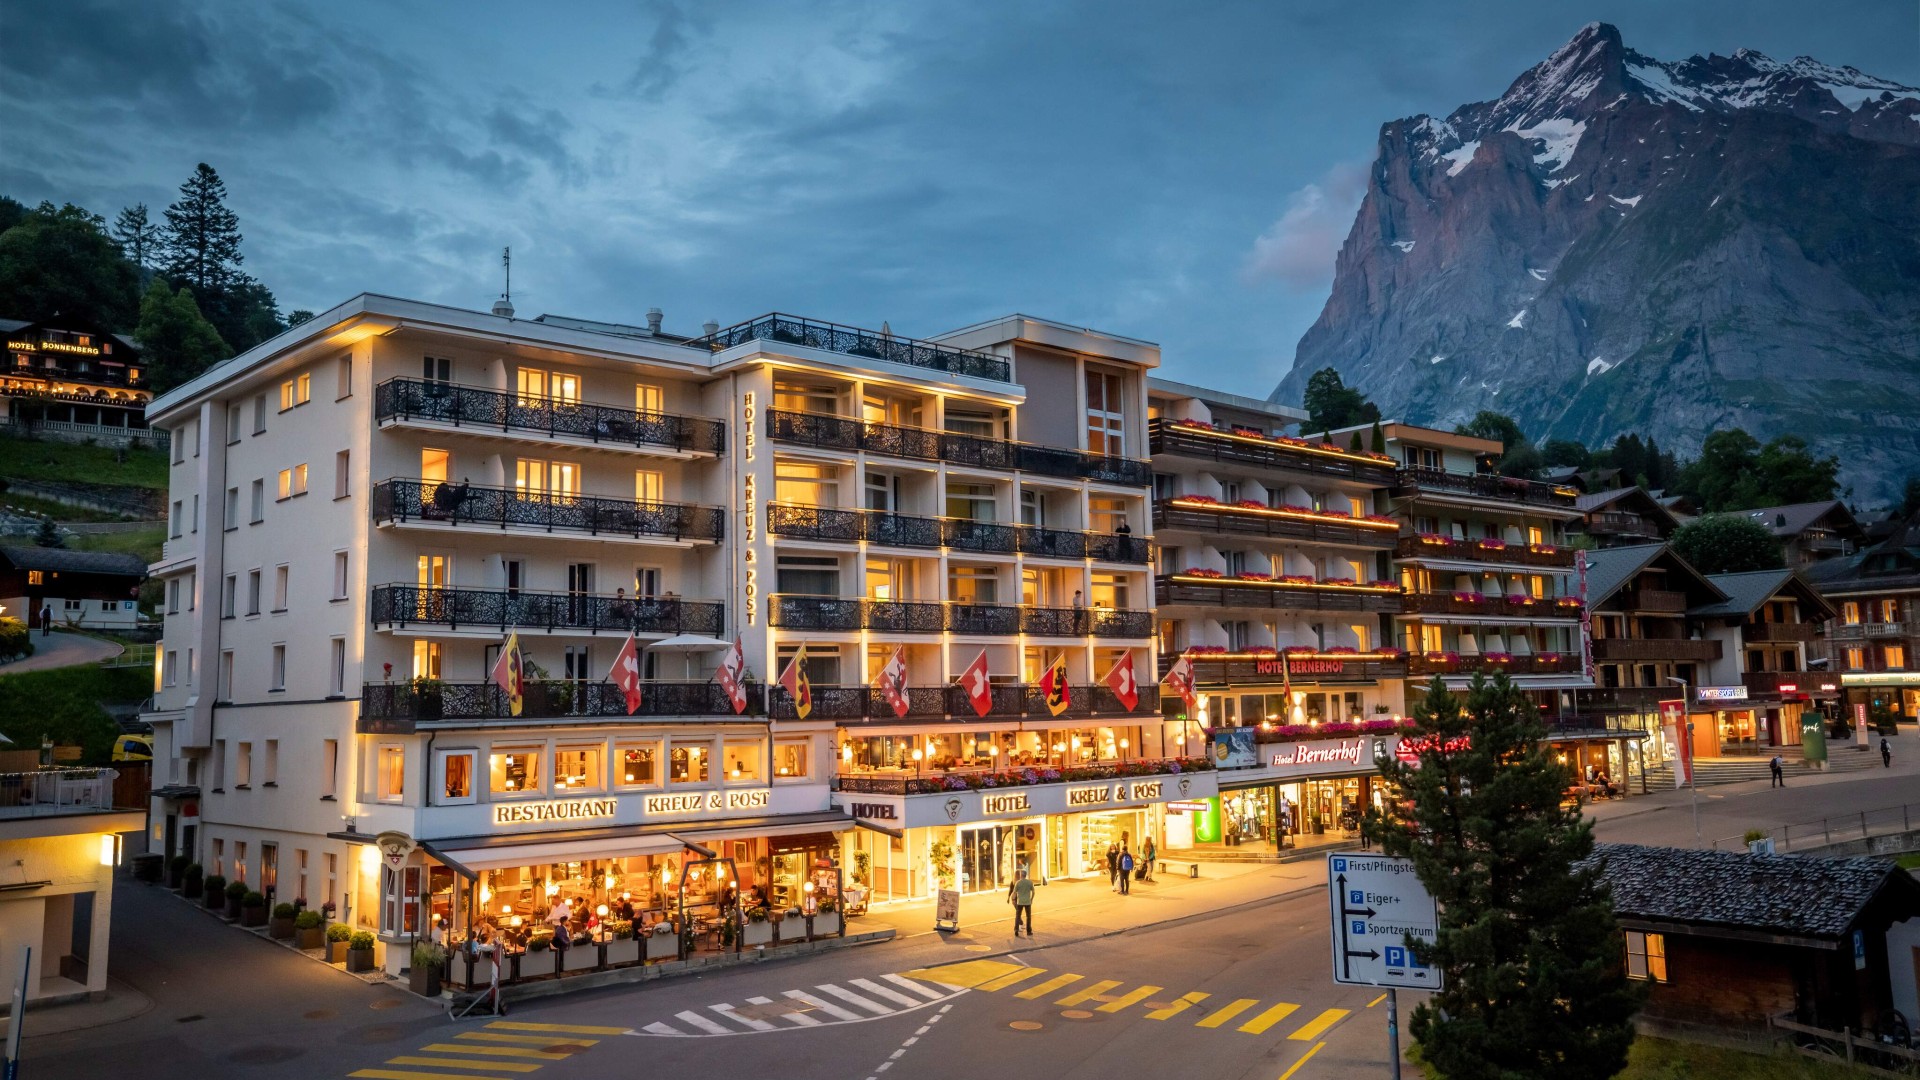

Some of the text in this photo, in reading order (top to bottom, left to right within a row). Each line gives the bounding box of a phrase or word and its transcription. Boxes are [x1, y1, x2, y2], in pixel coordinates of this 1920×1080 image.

[8, 341, 99, 355] HOTEL SONNENBERG
[744, 393, 755, 624] HOTEL KREUZ & POST
[1257, 660, 1344, 674] HOTE BERNERHOF
[1274, 740, 1365, 766] Hotel Bernerhof
[985, 783, 1163, 813] HOTEL KREUZ & POST
[496, 791, 770, 822] RESTAURANT KREUZ & POST
[851, 802, 898, 820] HOTEL
[1349, 860, 1415, 875] First/Pfingste
[1366, 892, 1401, 906] Eiger+
[1368, 923, 1434, 937] Sportzentrum
